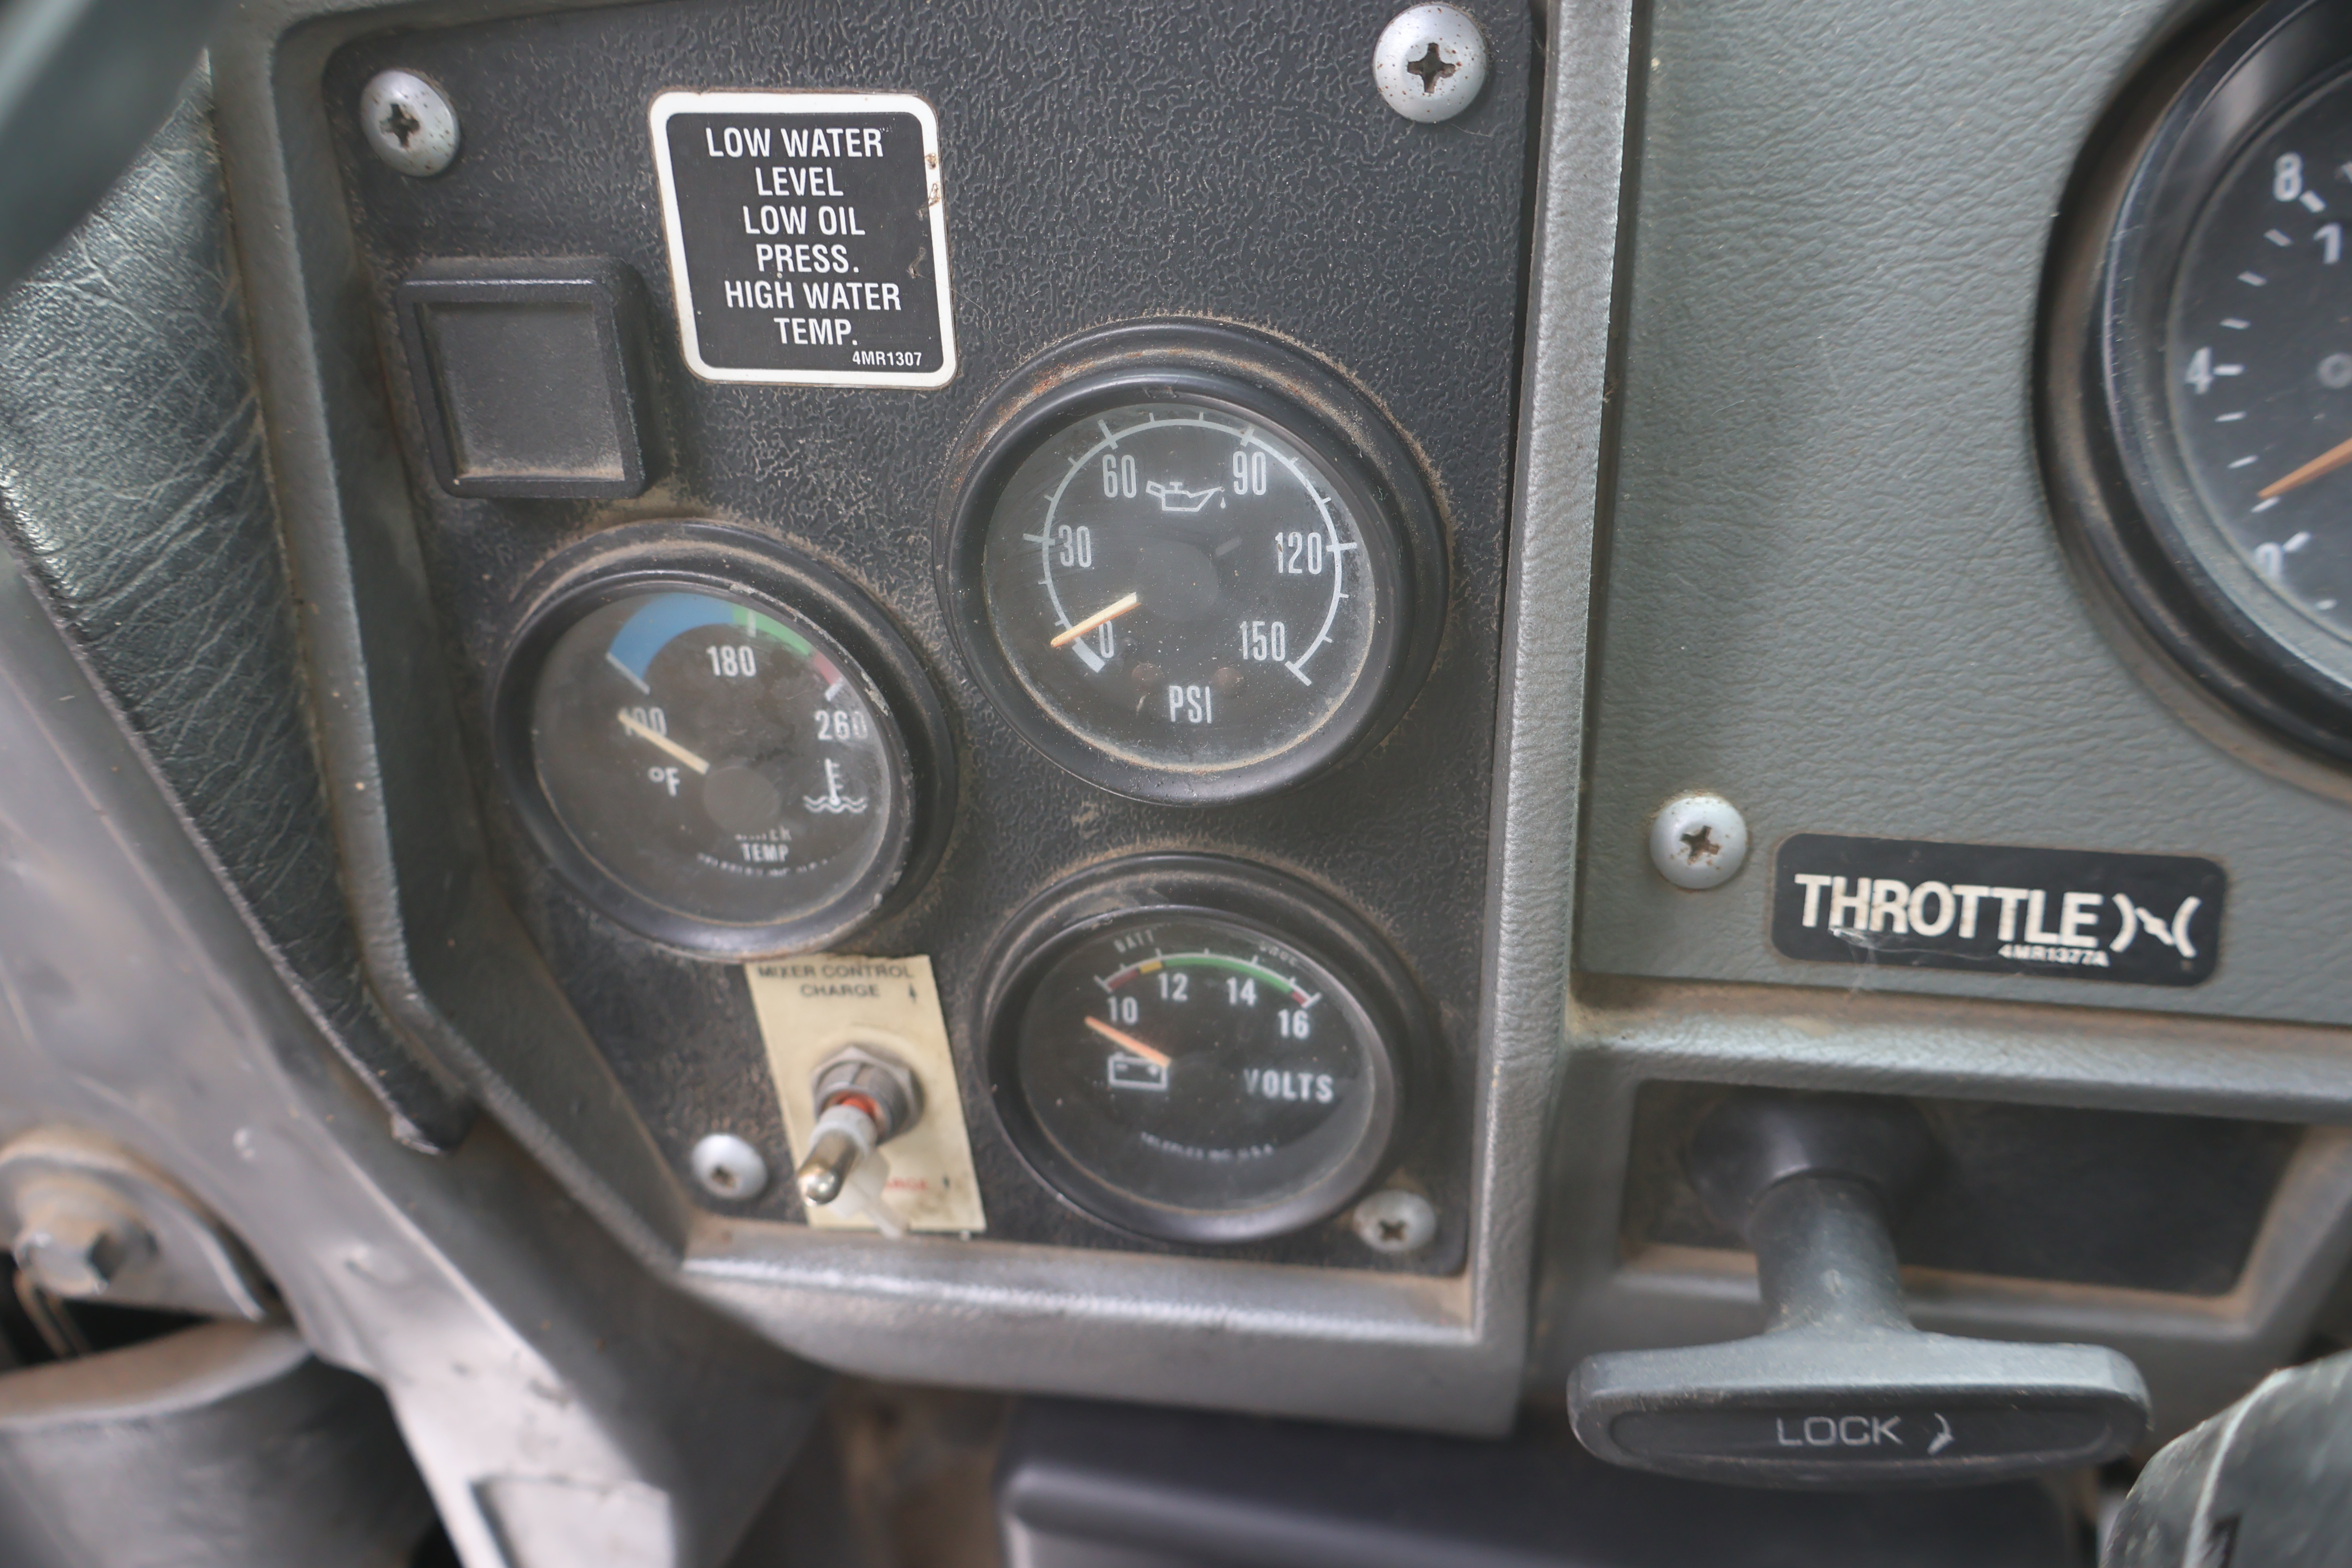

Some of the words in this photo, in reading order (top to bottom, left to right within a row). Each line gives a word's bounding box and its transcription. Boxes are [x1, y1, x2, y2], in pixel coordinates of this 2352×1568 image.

[706, 127, 771, 157] LOW
[780, 128, 884, 157] WATER
[755, 167, 844, 196] LEVEL
[2273, 152, 2303, 202] 8
[742, 205, 806, 235] LOW
[818, 206, 866, 235] OIL
[755, 243, 859, 273] PRESS.
[724, 280, 795, 309] HIGH
[802, 282, 902, 310] WATER
[773, 318, 858, 346] TEMP.
[852, 351, 922, 367] 4MR1307
[2185, 346, 2215, 394] 4
[1102, 454, 1136, 498] 60
[1233, 450, 1267, 495] 90
[1058, 524, 1092, 567] 30
[1274, 532, 1323, 575] 120
[1098, 620, 1114, 659] 0
[1239, 620, 1285, 662] 150
[706, 645, 757, 677] 180
[1169, 685, 1212, 724] PSI
[814, 710, 868, 740] 260
[739, 842, 789, 862] TEMP
[1794, 873, 2103, 948] THROTTLE
[758, 964, 816, 979] MIXER
[822, 964, 915, 980] CONTROL
[1158, 972, 1189, 1001] 12
[800, 984, 880, 998] CHARGE
[1226, 977, 1257, 1006] 14
[1107, 996, 1139, 1025] 10
[1277, 1009, 1310, 1039] 16
[1243, 1069, 1334, 1104] VOLTS
[1777, 1416, 1904, 1446] LOCK
